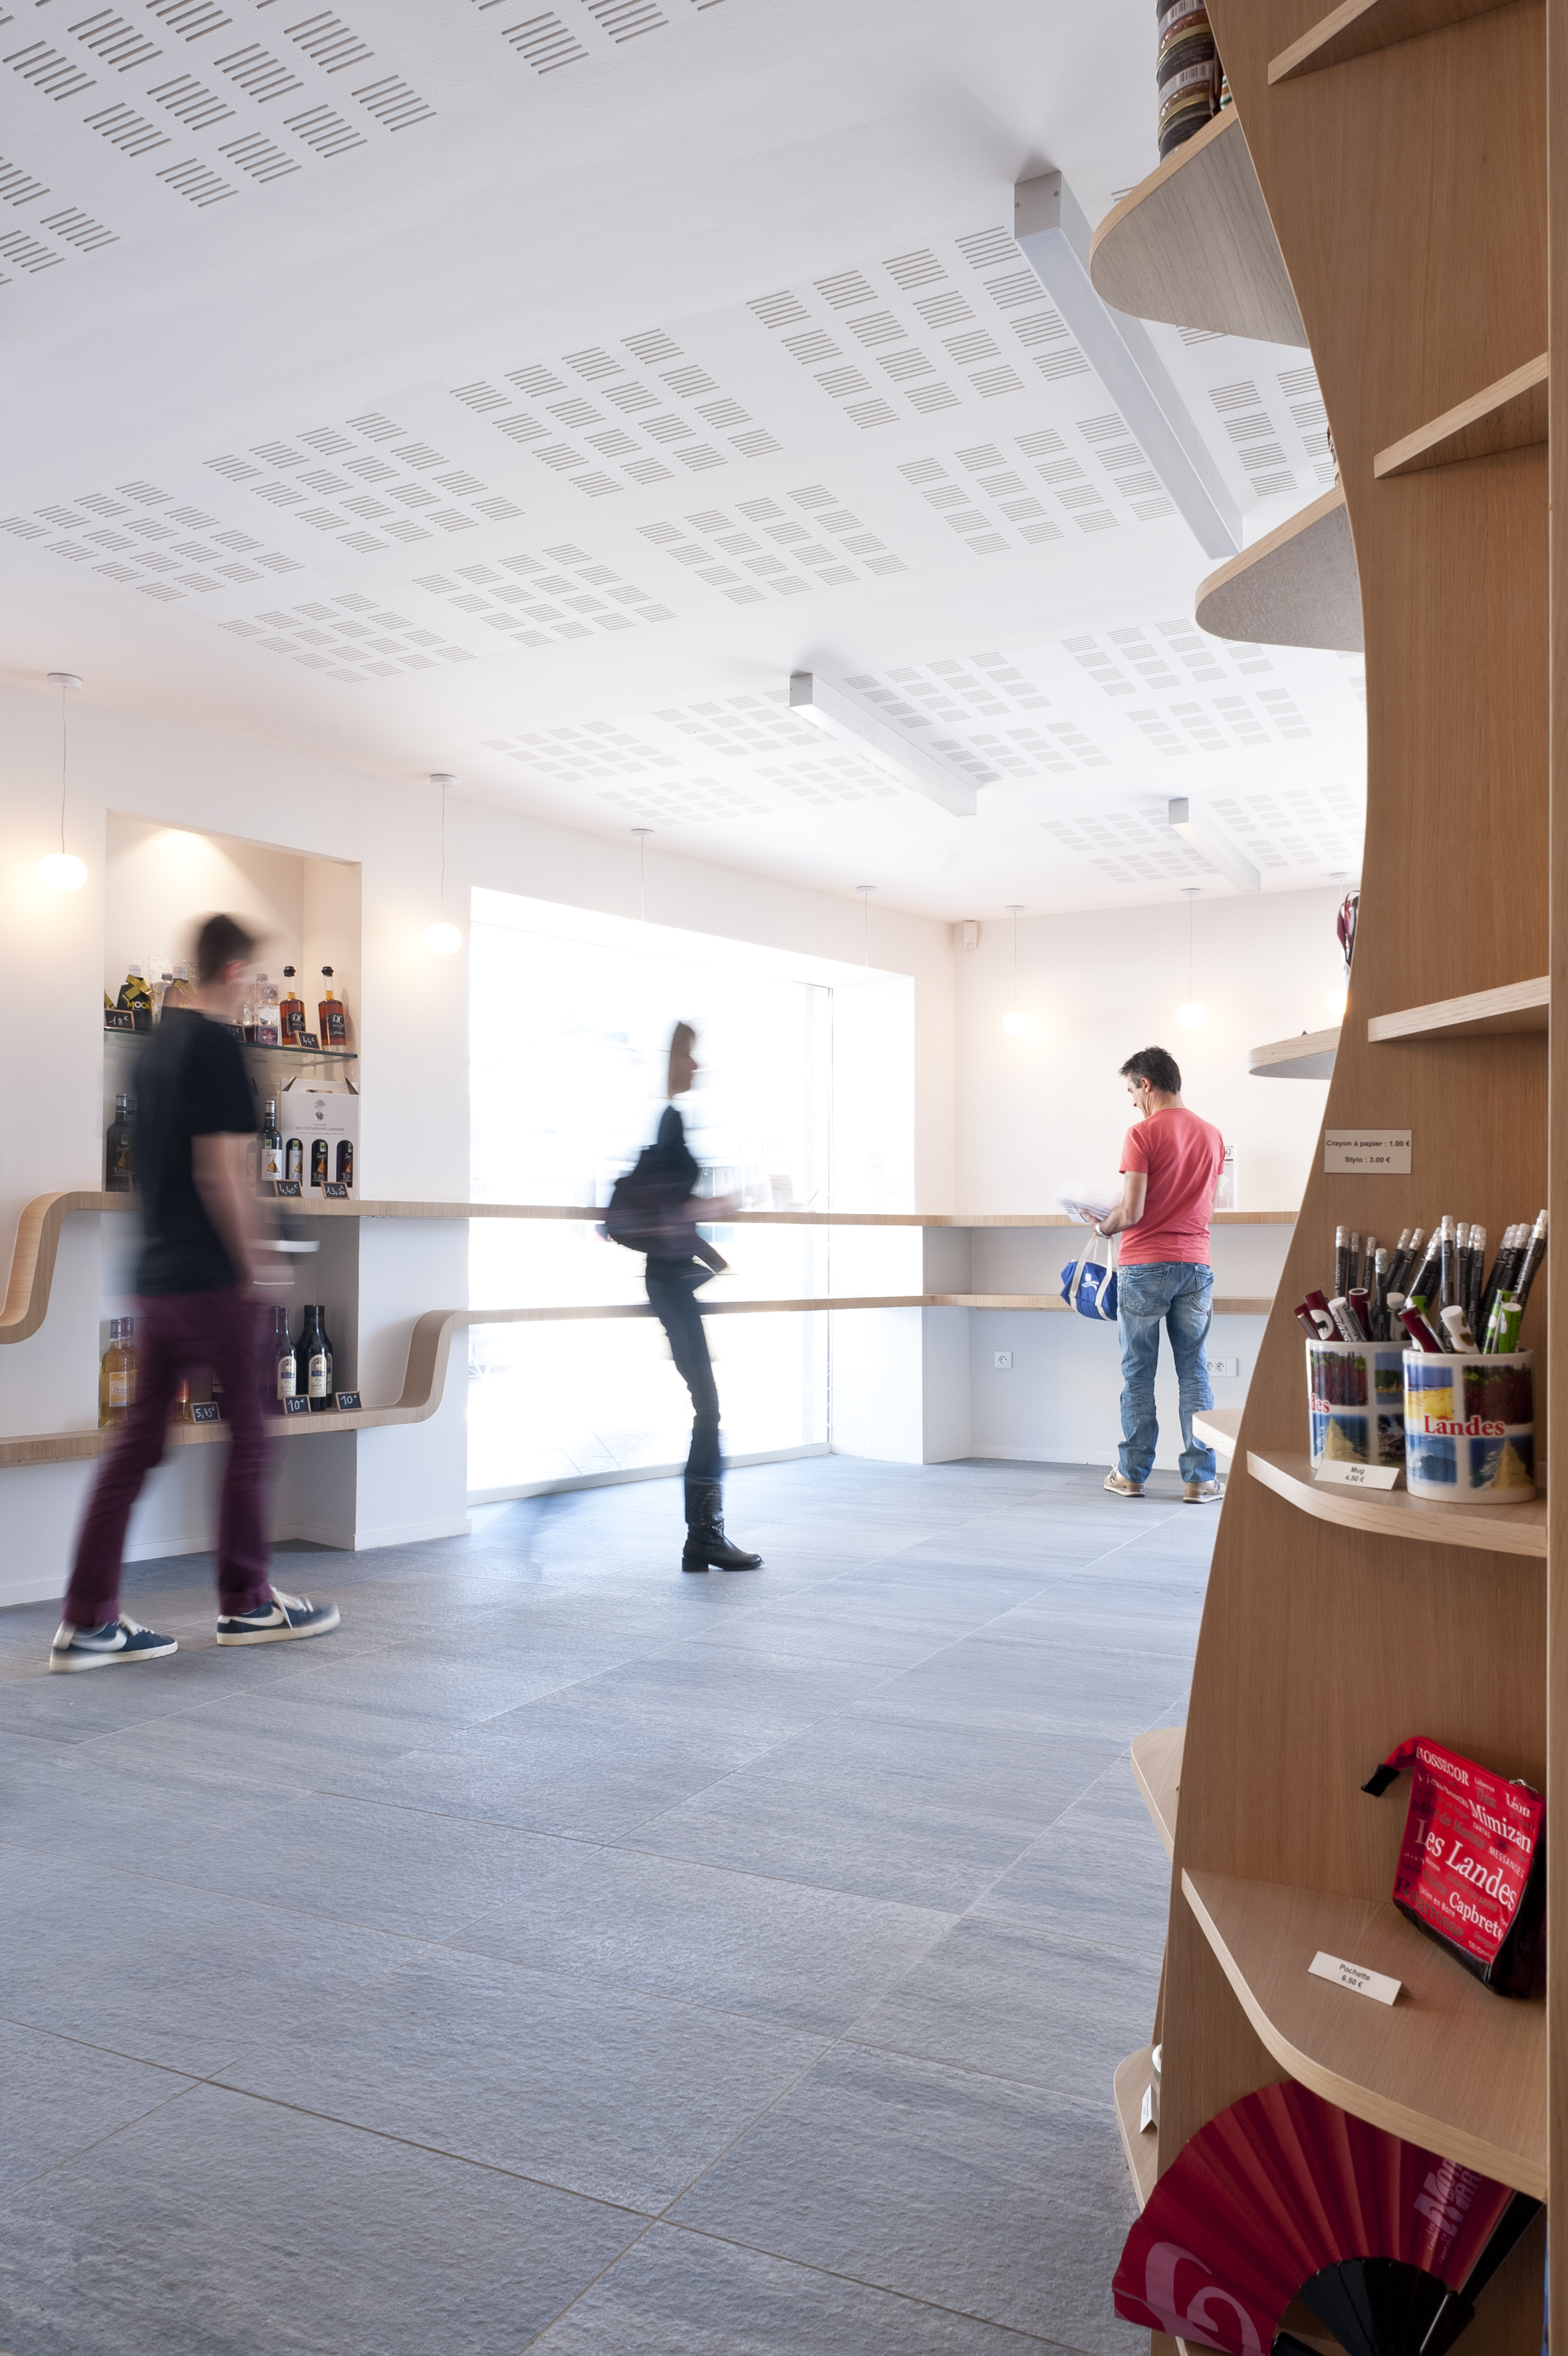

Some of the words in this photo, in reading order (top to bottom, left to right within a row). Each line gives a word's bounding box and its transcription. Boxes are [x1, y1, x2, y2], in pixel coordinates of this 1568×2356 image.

[1309, 1392, 1330, 1413] des
[1423, 1415, 1505, 1436] Landes
[1351, 1466, 1365, 1476] Mug
[1416, 1746, 1469, 1786] HOSSEGOR
[1477, 1788, 1497, 1809] Dax
[1505, 1793, 1531, 1817] Léon
[1440, 1811, 1452, 1827] de
[1452, 1819, 1486, 1850] Marsan
[1468, 1798, 1531, 1853] Mimizan
[1472, 1821, 1491, 1839] TARTAS
[1415, 1818, 1446, 1857] Les
[1445, 1840, 1517, 1912] Landes
[1433, 1897, 1441, 1907] en
[1442, 1902, 1456, 1918] Born
[1339, 1964, 1371, 1981] Pochette
[1341, 1975, 1357, 1986] 6.50
